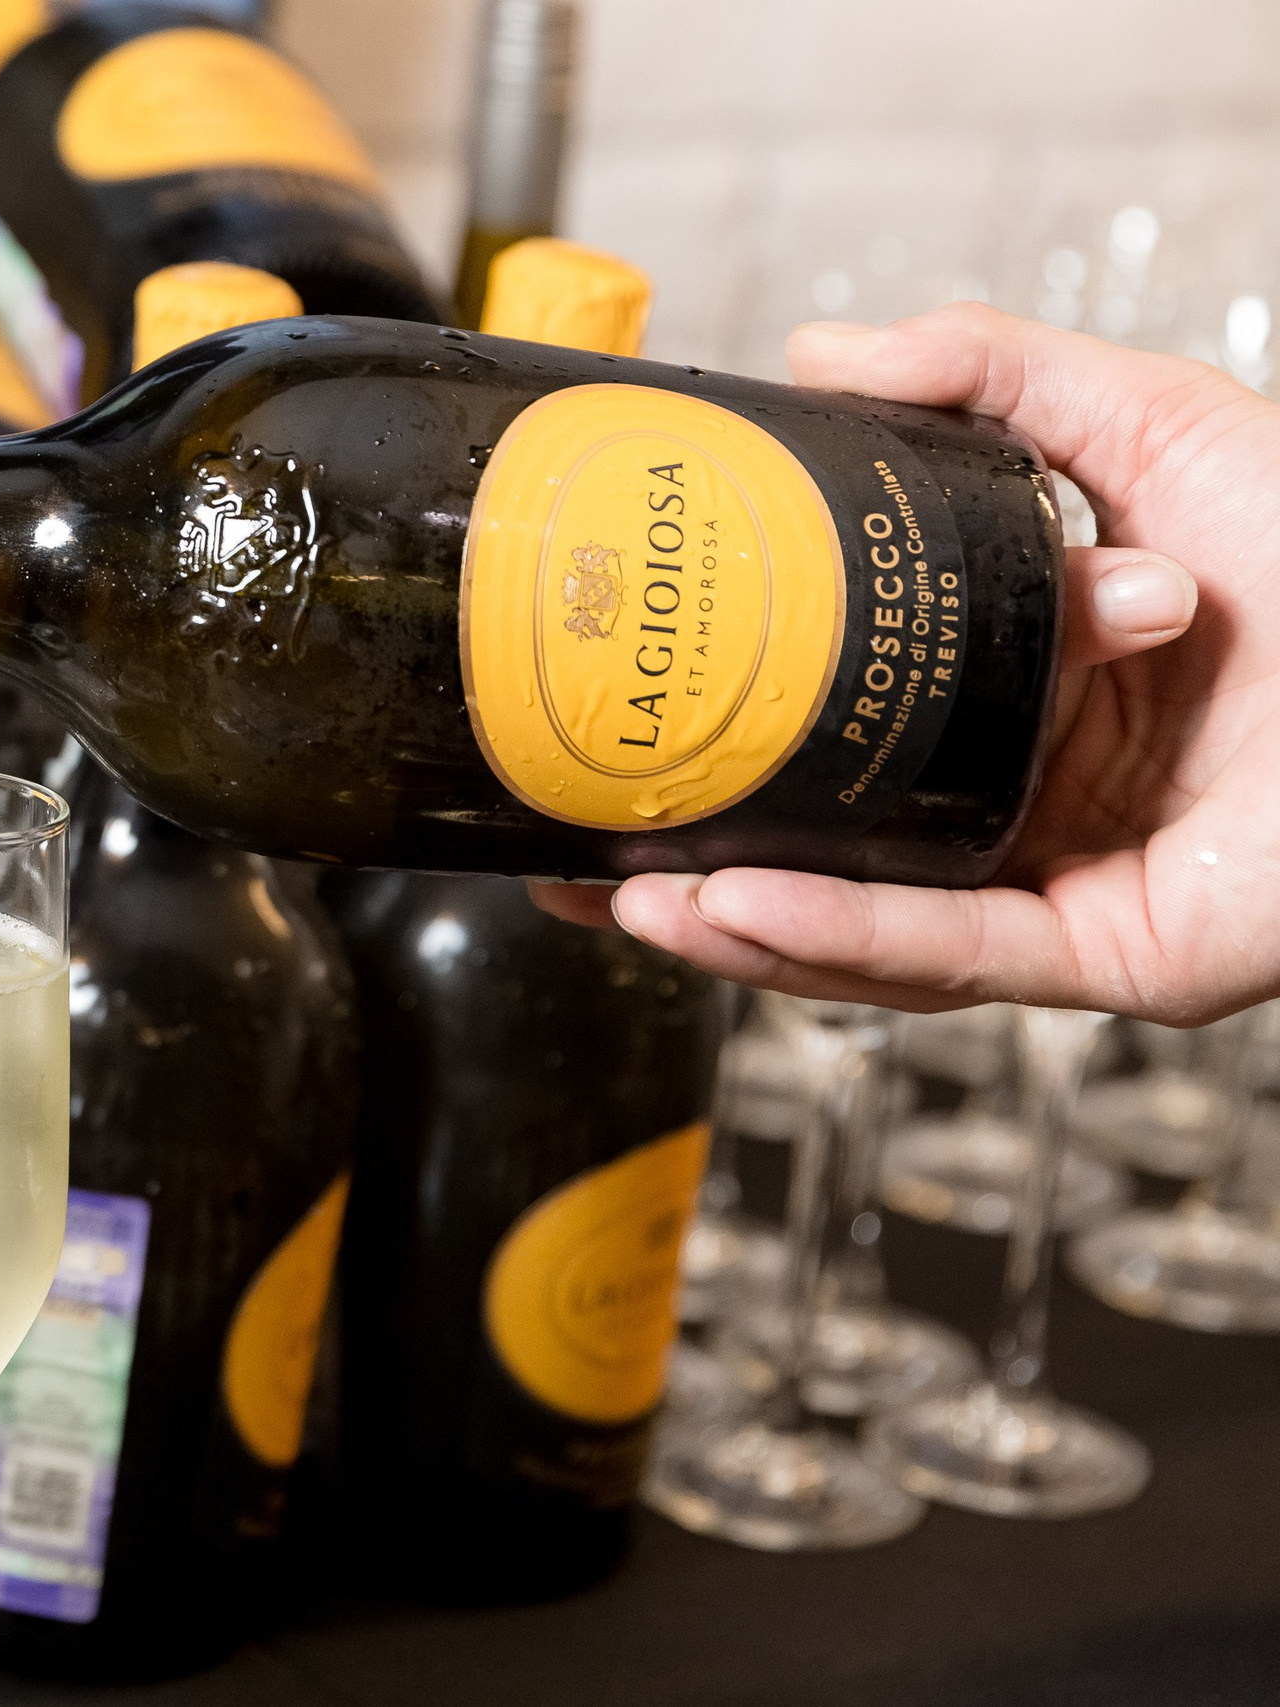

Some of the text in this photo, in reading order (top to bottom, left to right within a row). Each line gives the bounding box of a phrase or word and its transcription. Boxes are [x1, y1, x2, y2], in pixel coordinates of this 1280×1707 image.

[619, 461, 686, 750] LA GIOIOSA
[687, 518, 719, 697] ET AMOROSA
[837, 460, 935, 805] Denominazione di Origine Controllata
[842, 512, 904, 746] PROSECCO
[928, 571, 960, 700] TREVISO
